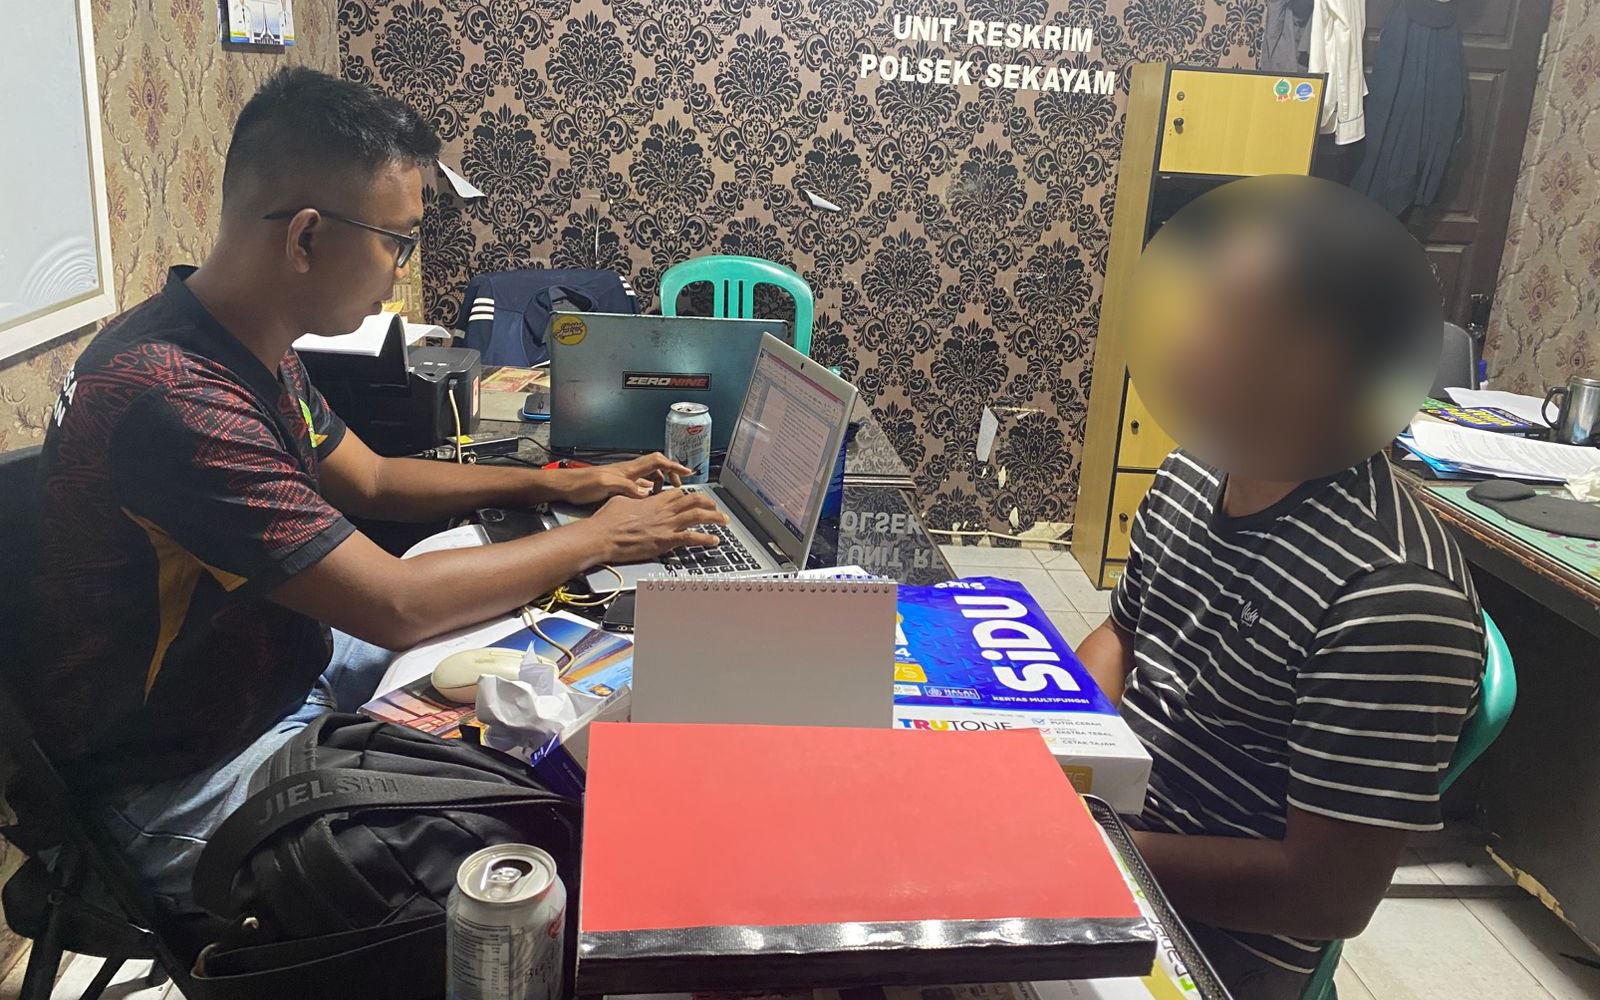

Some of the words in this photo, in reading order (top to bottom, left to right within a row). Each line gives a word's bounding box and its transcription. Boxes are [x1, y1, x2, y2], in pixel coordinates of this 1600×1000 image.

[893, 14, 957, 43] UNIT
[966, 20, 1093, 53] RESKRIM
[860, 53, 974, 86] POLSEK
[985, 63, 1116, 95] SEKAYAM
